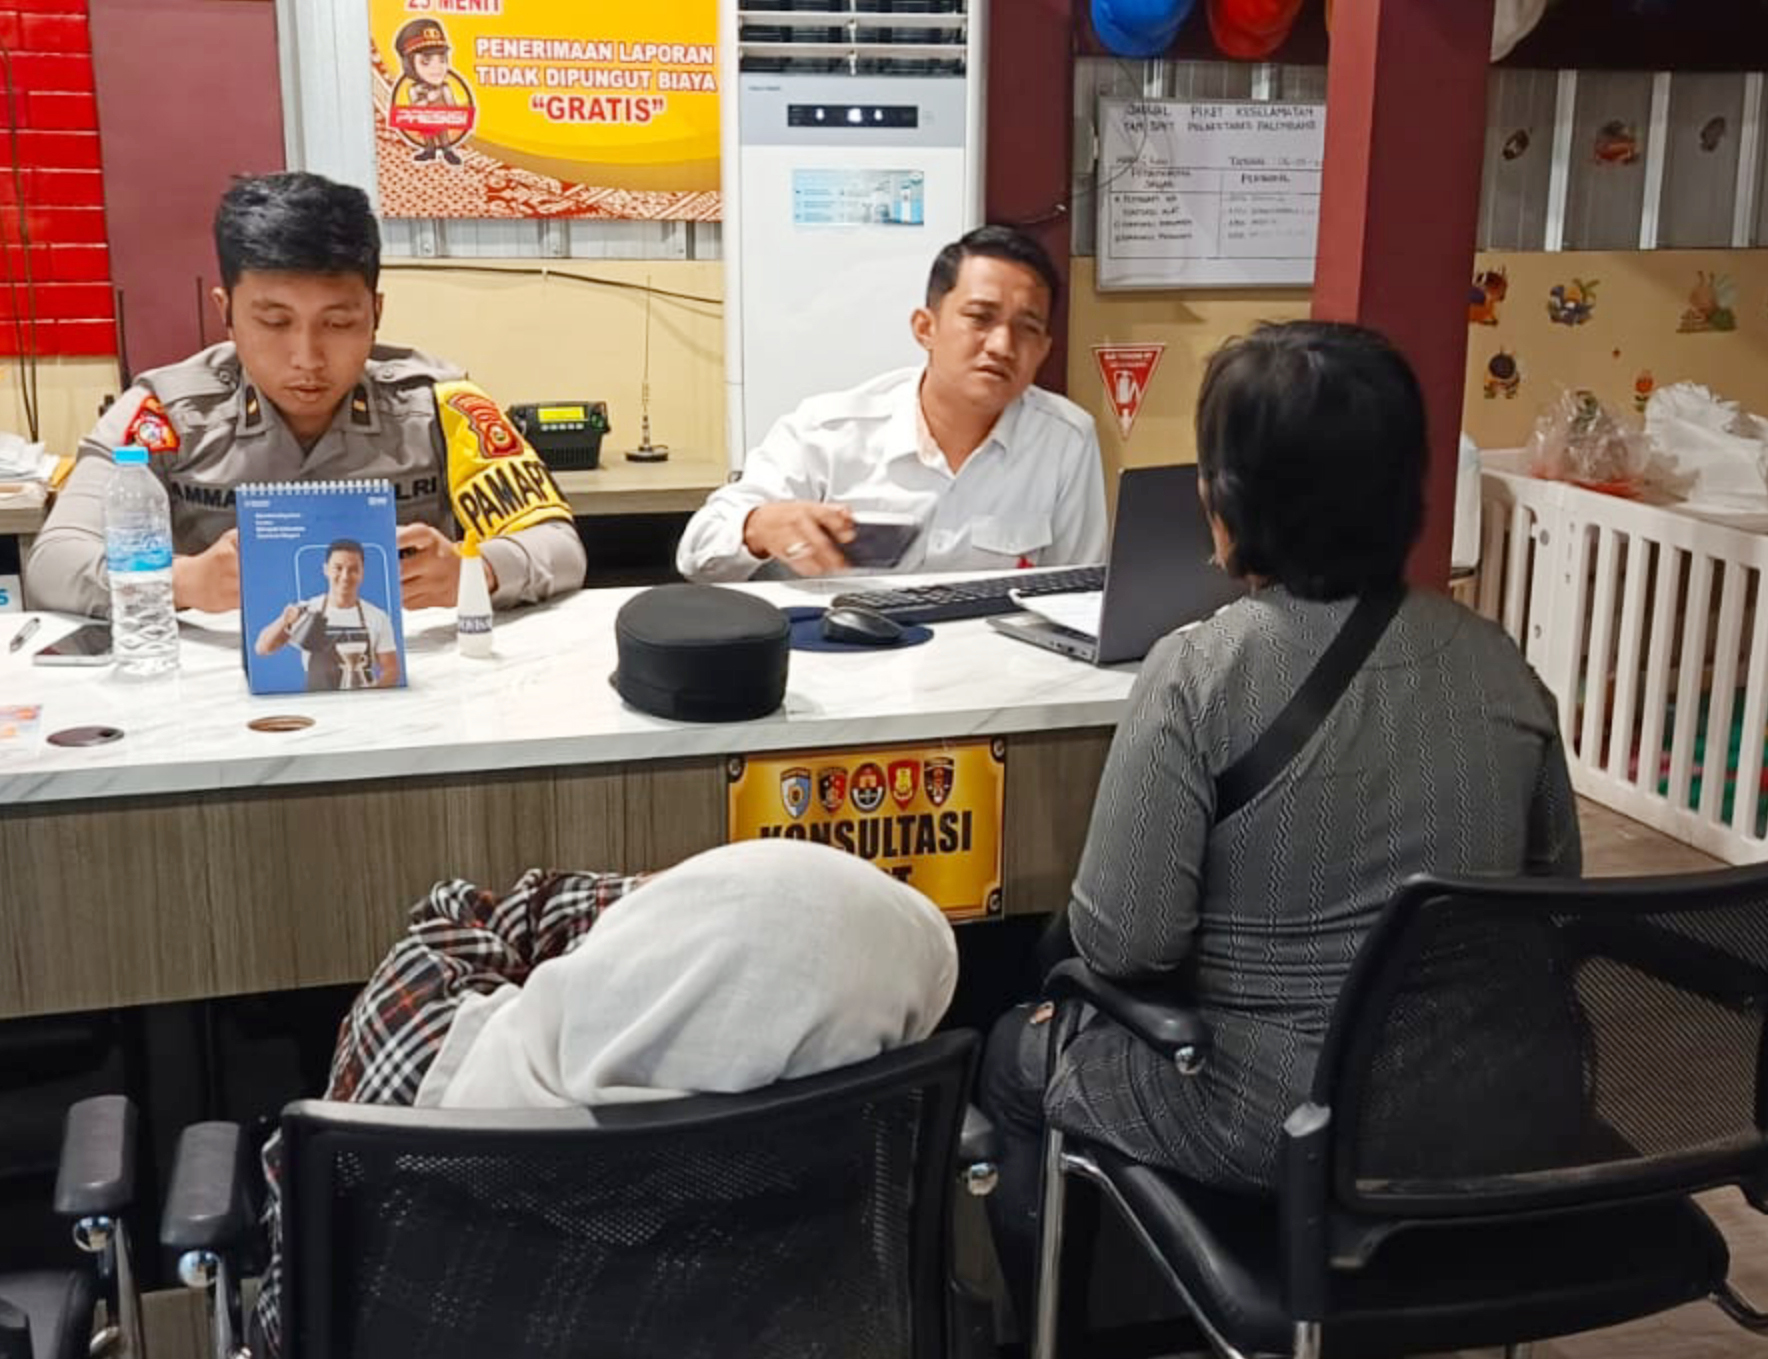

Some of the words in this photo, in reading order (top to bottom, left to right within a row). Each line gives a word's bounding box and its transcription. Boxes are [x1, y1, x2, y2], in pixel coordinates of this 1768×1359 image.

[475, 38, 615, 61] PENERIMAAN
[619, 43, 714, 64] LAPORAN
[476, 66, 540, 87] TIDAK
[546, 68, 651, 90] DIPUNGUT
[658, 72, 717, 92] BIAYA
[395, 476, 437, 500] LRI
